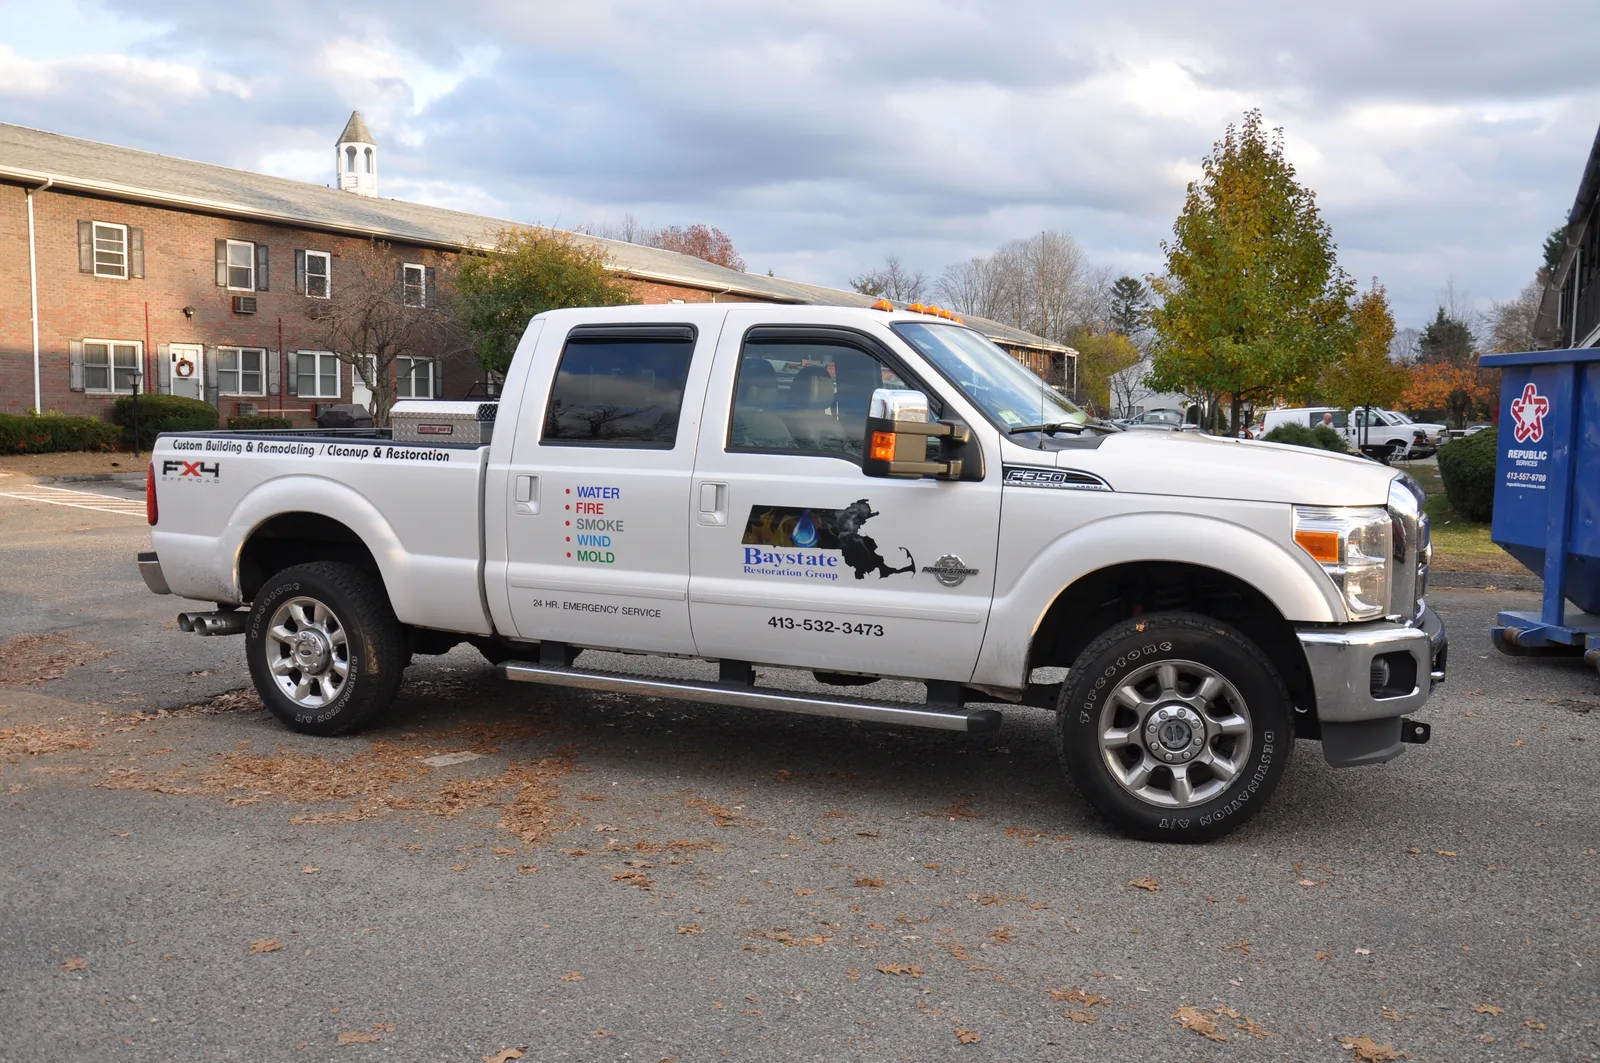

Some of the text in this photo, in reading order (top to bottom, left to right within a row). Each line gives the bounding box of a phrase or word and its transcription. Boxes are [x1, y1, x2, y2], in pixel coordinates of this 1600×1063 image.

[173, 440, 450, 461] Custom Building & Remodeling / Cleanup & Restoration
[1508, 449, 1547, 460] REPUBLIC
[162, 460, 220, 478] FX4
[1506, 471, 1547, 482] 413-557-6700
[577, 486, 620, 499] WATER
[576, 502, 604, 515] FIRE
[576, 518, 624, 532] SMOKE
[577, 534, 611, 547] WIND
[577, 550, 615, 563] MOLD
[742, 547, 838, 567] Baystate
[743, 565, 838, 581] Restoration Group
[533, 599, 661, 618] 24 HR. EMERGENCY SERVICE
[767, 616, 884, 637] 413-532-3473
[1159, 731, 1275, 829] DESTINATION A/T
